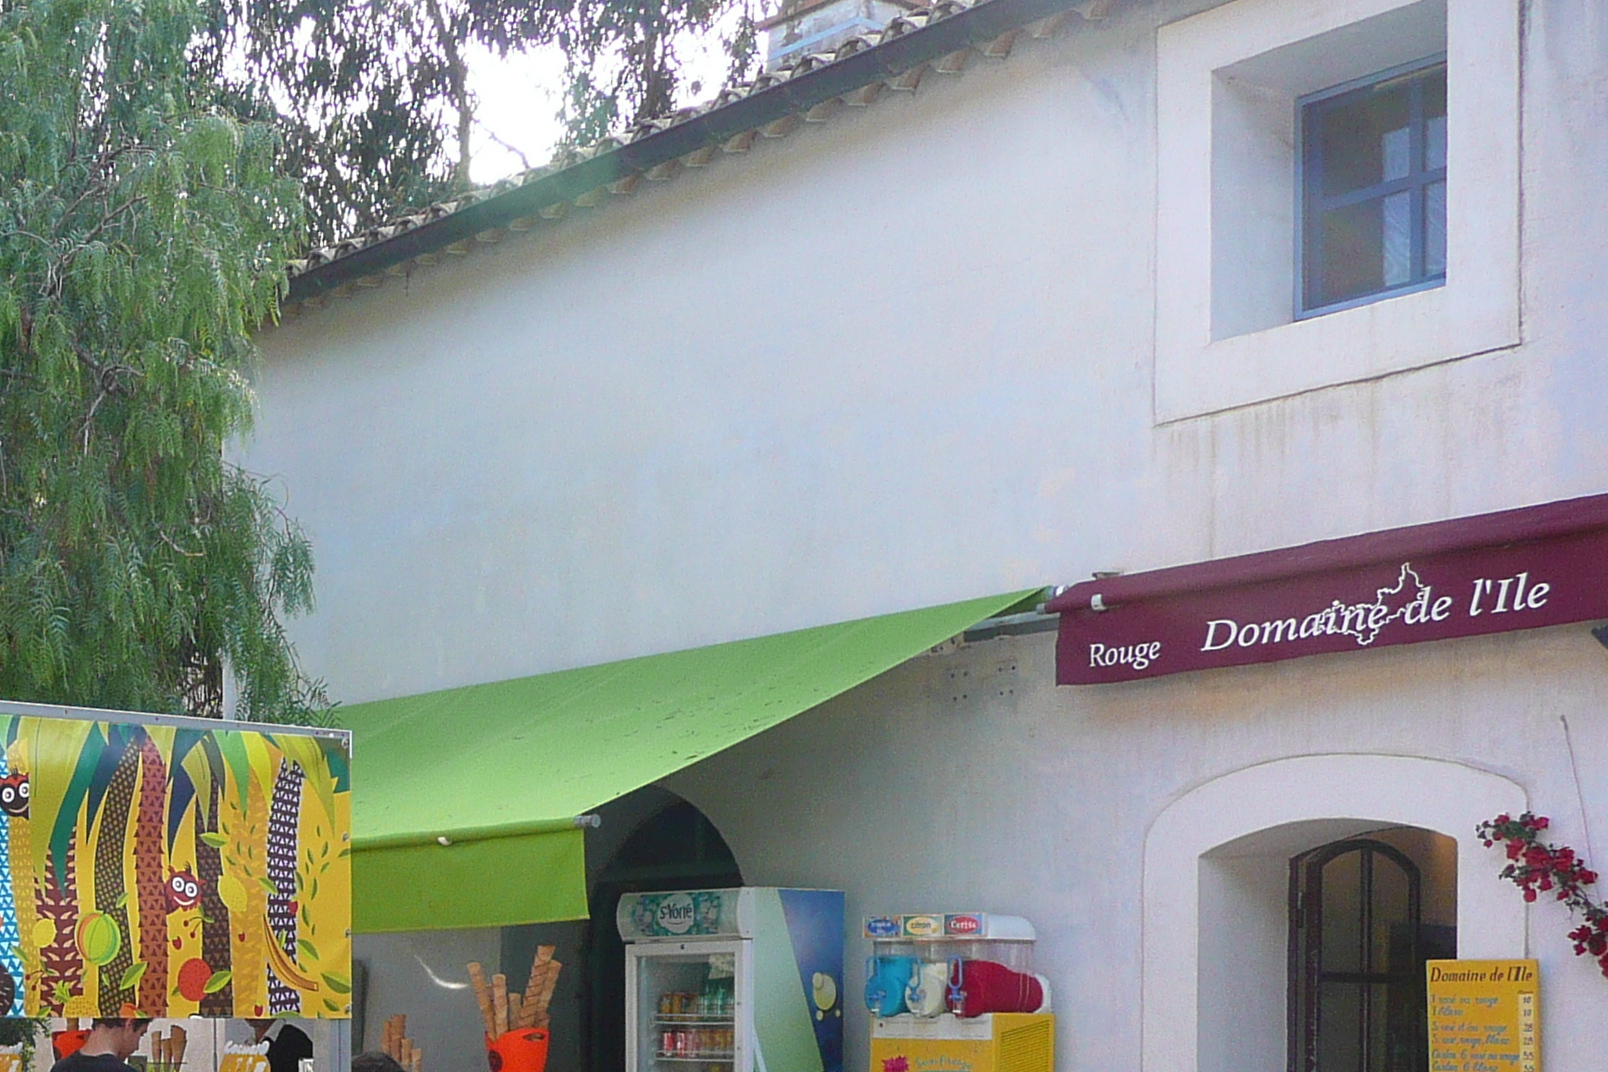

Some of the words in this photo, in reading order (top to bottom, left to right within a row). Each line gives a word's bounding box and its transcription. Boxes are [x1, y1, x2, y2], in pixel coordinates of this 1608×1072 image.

[1089, 641, 1161, 671] Rouge
[1201, 600, 1388, 652] Domaine
[1404, 586, 1453, 625] de
[1468, 571, 1551, 617] l'Ile
[1430, 966, 1486, 982] Domaine
[1489, 966, 1504, 981] de
